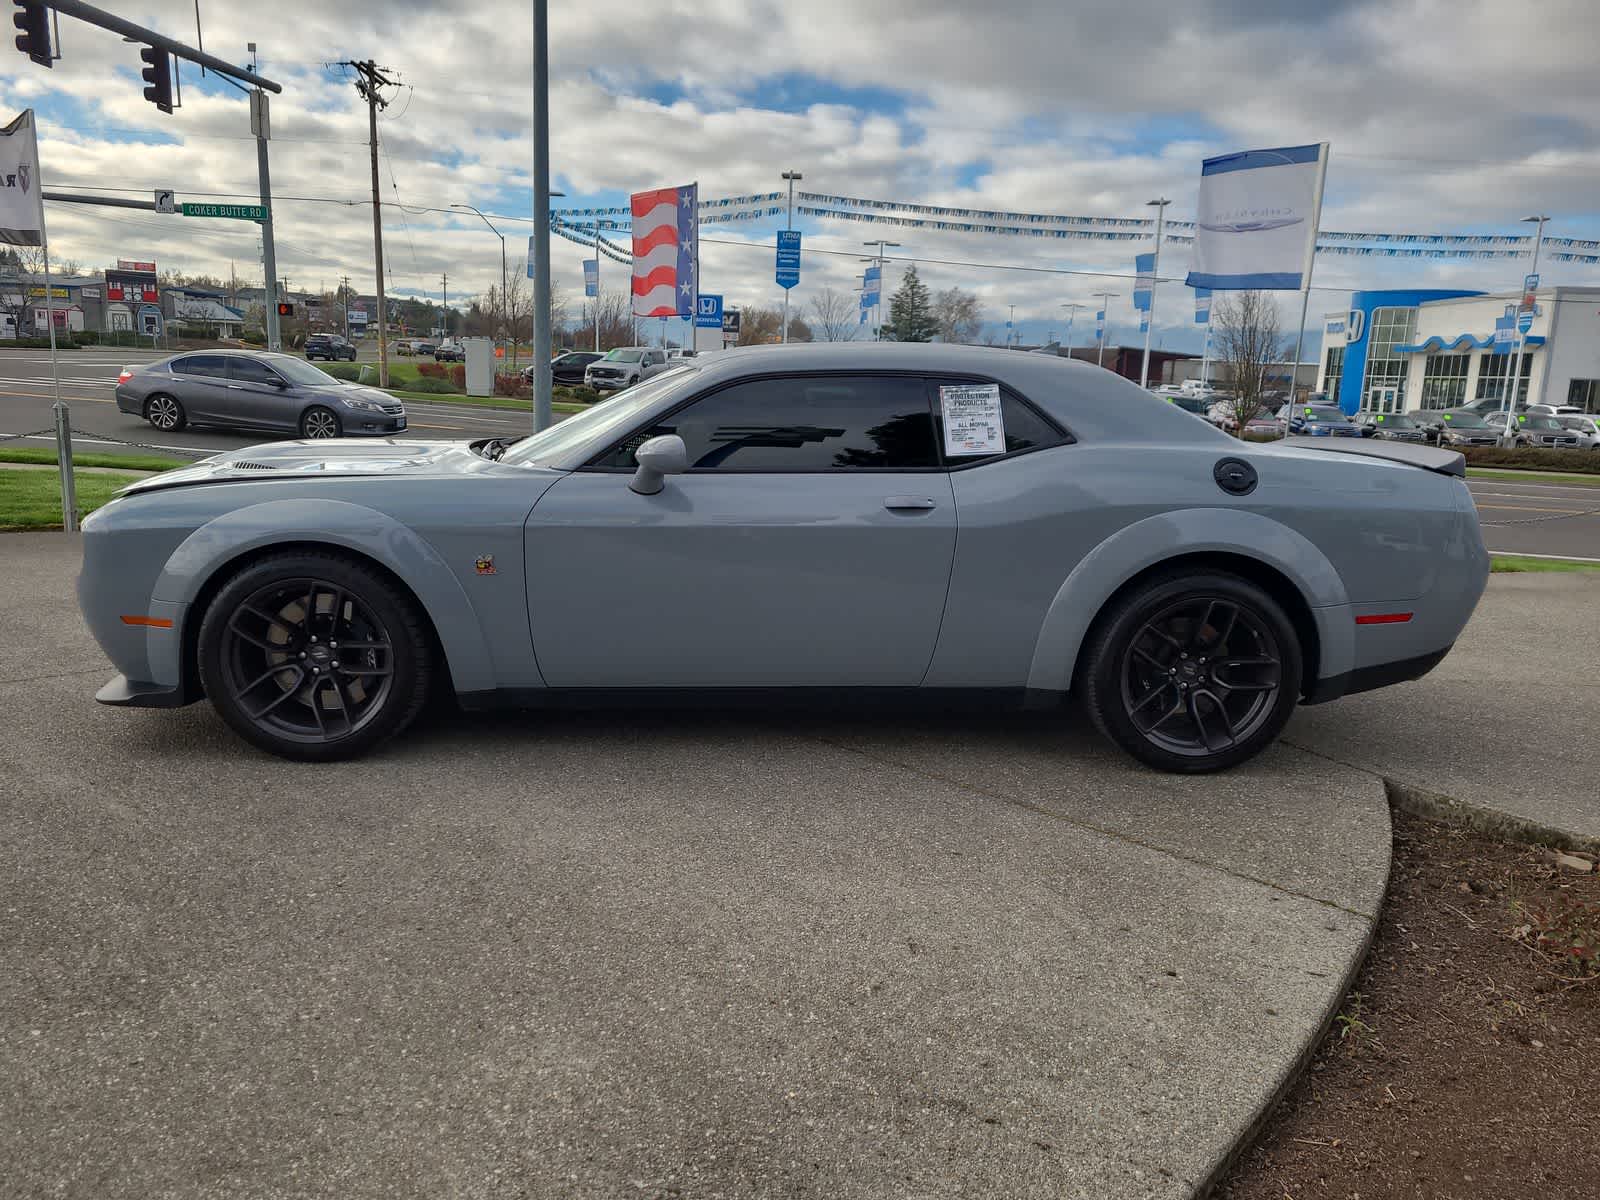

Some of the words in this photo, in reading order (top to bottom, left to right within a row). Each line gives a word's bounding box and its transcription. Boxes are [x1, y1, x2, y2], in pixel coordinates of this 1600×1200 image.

[188, 204, 217, 216] COKER
[220, 206, 248, 217] BUTTE
[250, 208, 262, 218] RD
[950, 392, 990, 400] PROTECTION
